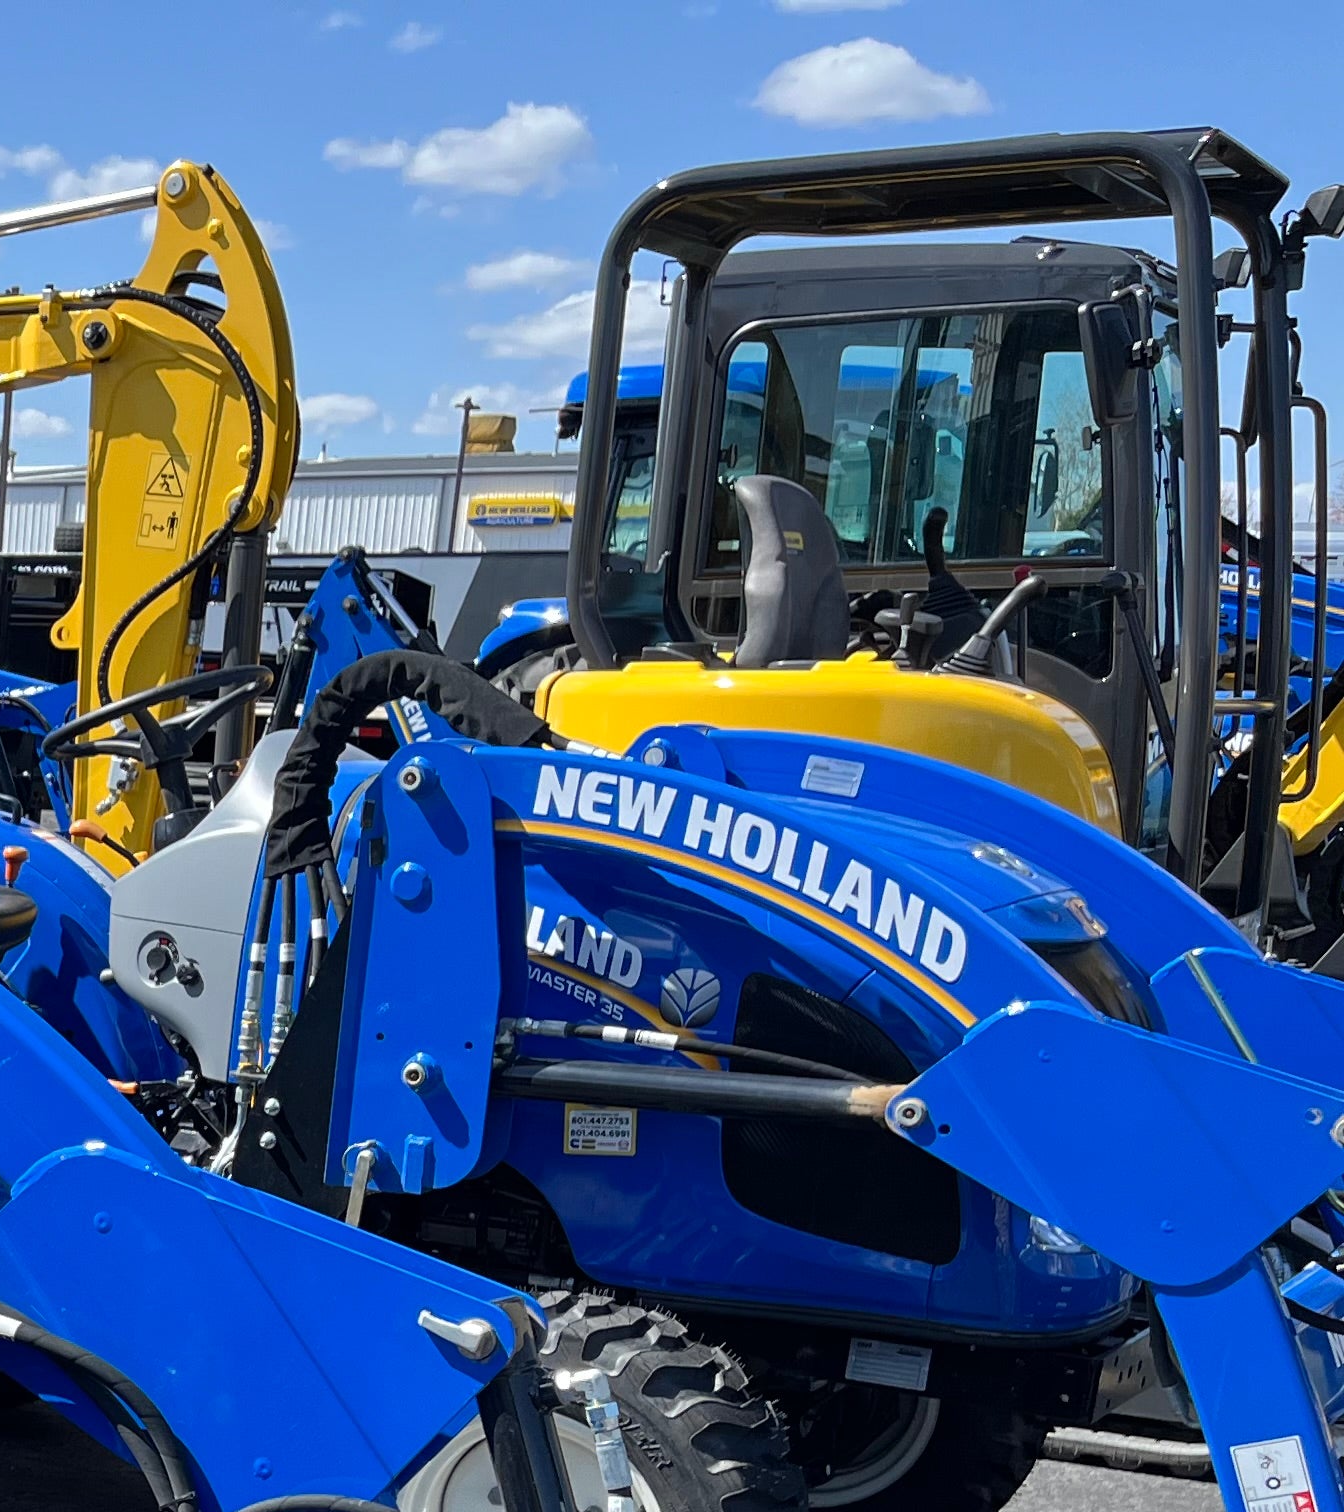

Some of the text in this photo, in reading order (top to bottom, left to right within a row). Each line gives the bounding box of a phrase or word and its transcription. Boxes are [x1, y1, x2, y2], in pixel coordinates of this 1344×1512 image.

[532, 765, 967, 984] NEW HOLLAND
[525, 905, 643, 988] LAND
[527, 965, 626, 1023] MASTER 35
